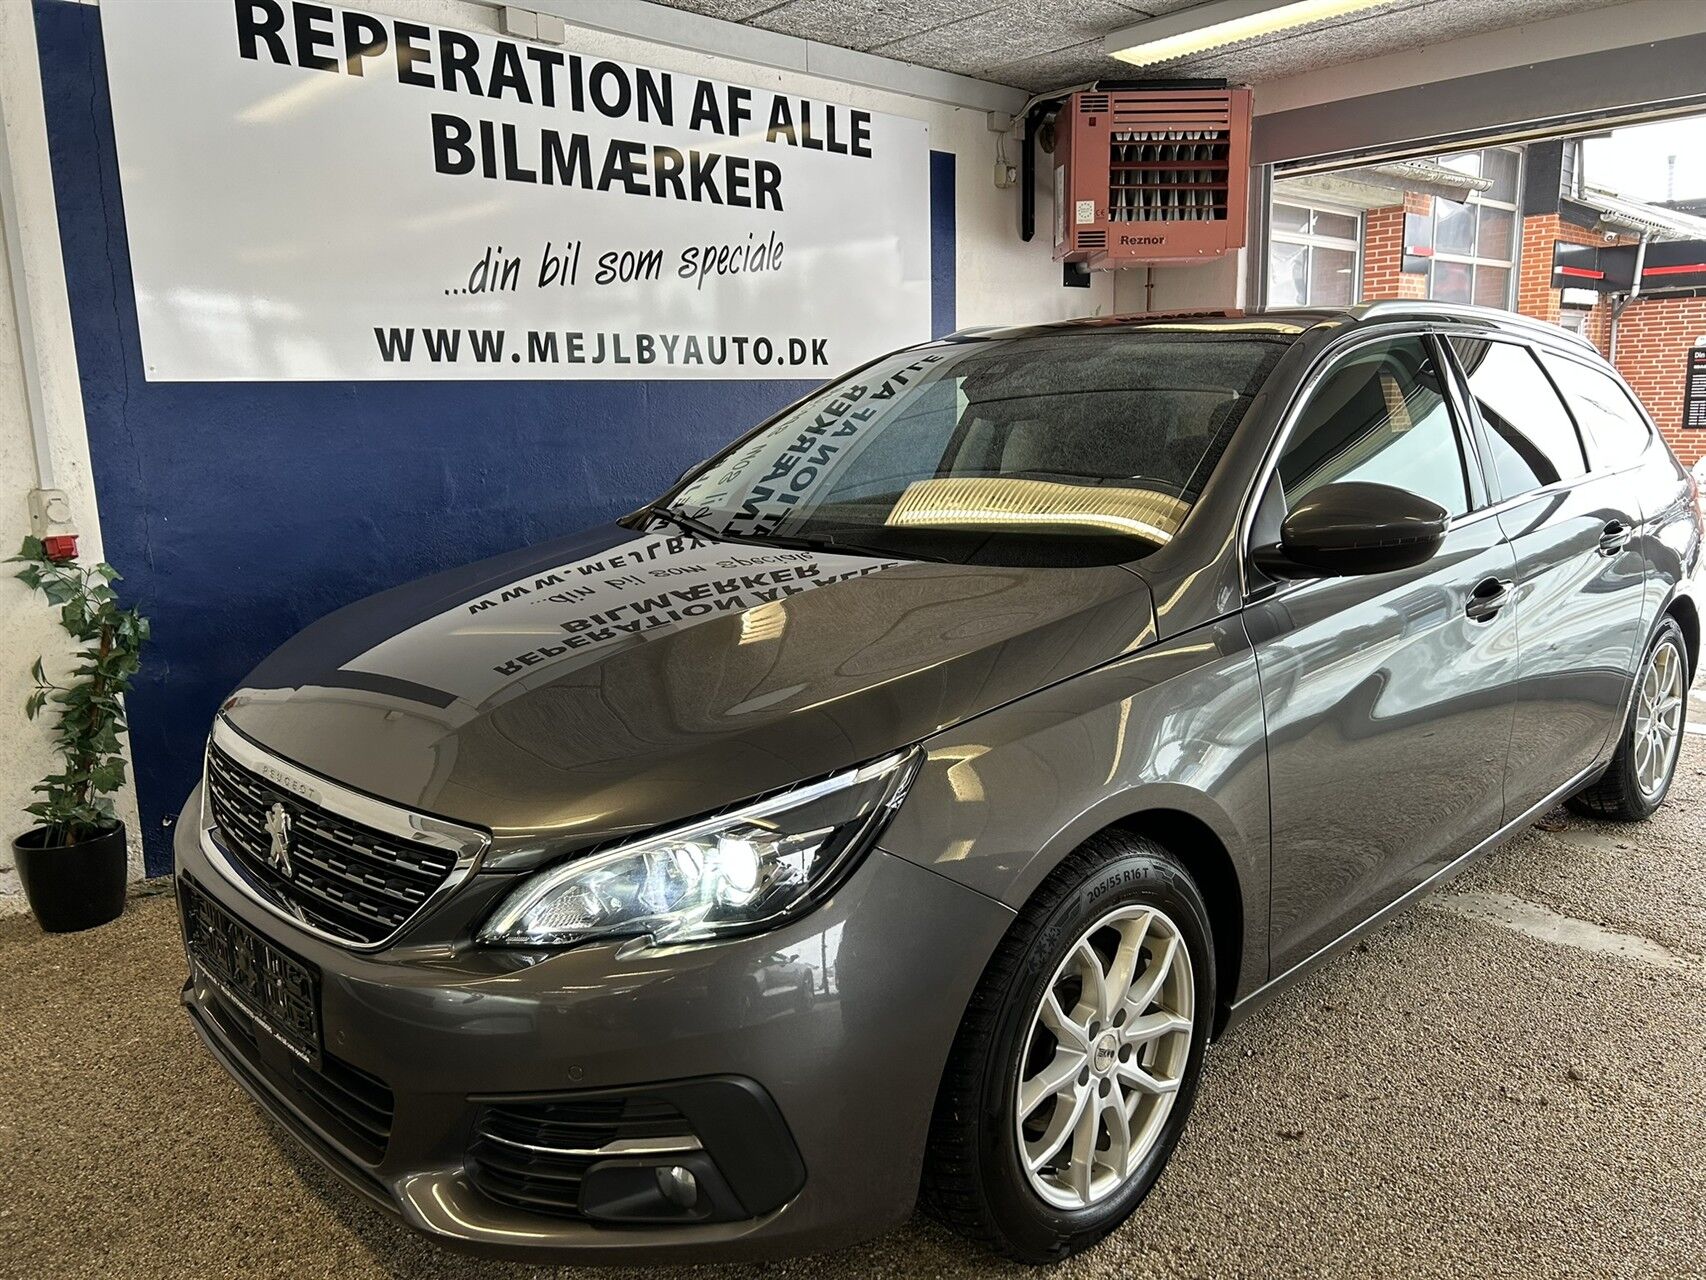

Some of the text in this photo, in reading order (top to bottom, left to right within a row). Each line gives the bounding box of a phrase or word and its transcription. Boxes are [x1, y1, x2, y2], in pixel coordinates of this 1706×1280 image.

[235, 0, 871, 158] REPERATION AF ALLE
[431, 114, 783, 211] BILMÆRKER
[1120, 235, 1165, 245] Reznor
[538, 241, 578, 288] bil
[595, 251, 664, 286] som
[678, 231, 783, 291] speciale
[374, 328, 828, 365] WWW.MEJLBYAUTO.DK
[263, 766, 315, 797] PEUGEOT
[1087, 868, 1149, 903] 205/55 R16 T
